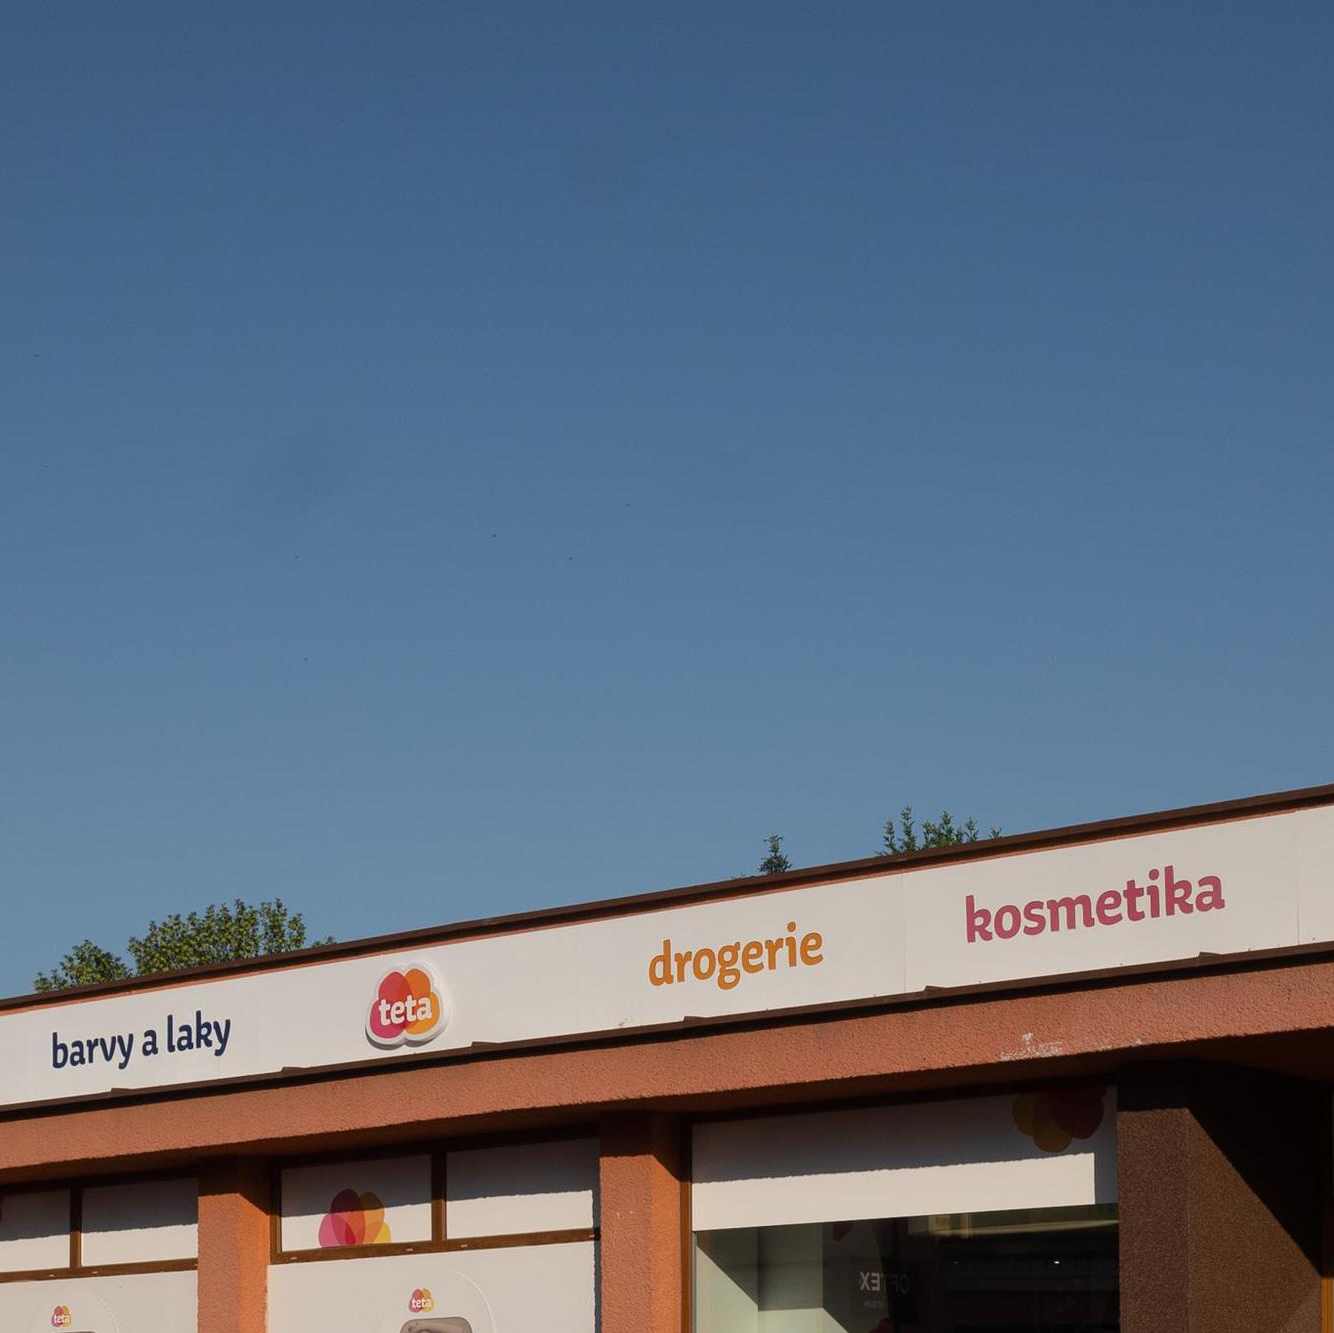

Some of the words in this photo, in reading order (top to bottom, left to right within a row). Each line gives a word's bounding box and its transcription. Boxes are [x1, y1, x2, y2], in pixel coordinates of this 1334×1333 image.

[964, 865, 1226, 944] kosmetika
[648, 921, 825, 990] drogerie
[51, 1031, 135, 1070] barvy
[141, 1029, 159, 1058] a
[166, 1010, 232, 1058] laky
[378, 994, 433, 1026] teta
[411, 1298, 432, 1309] teta
